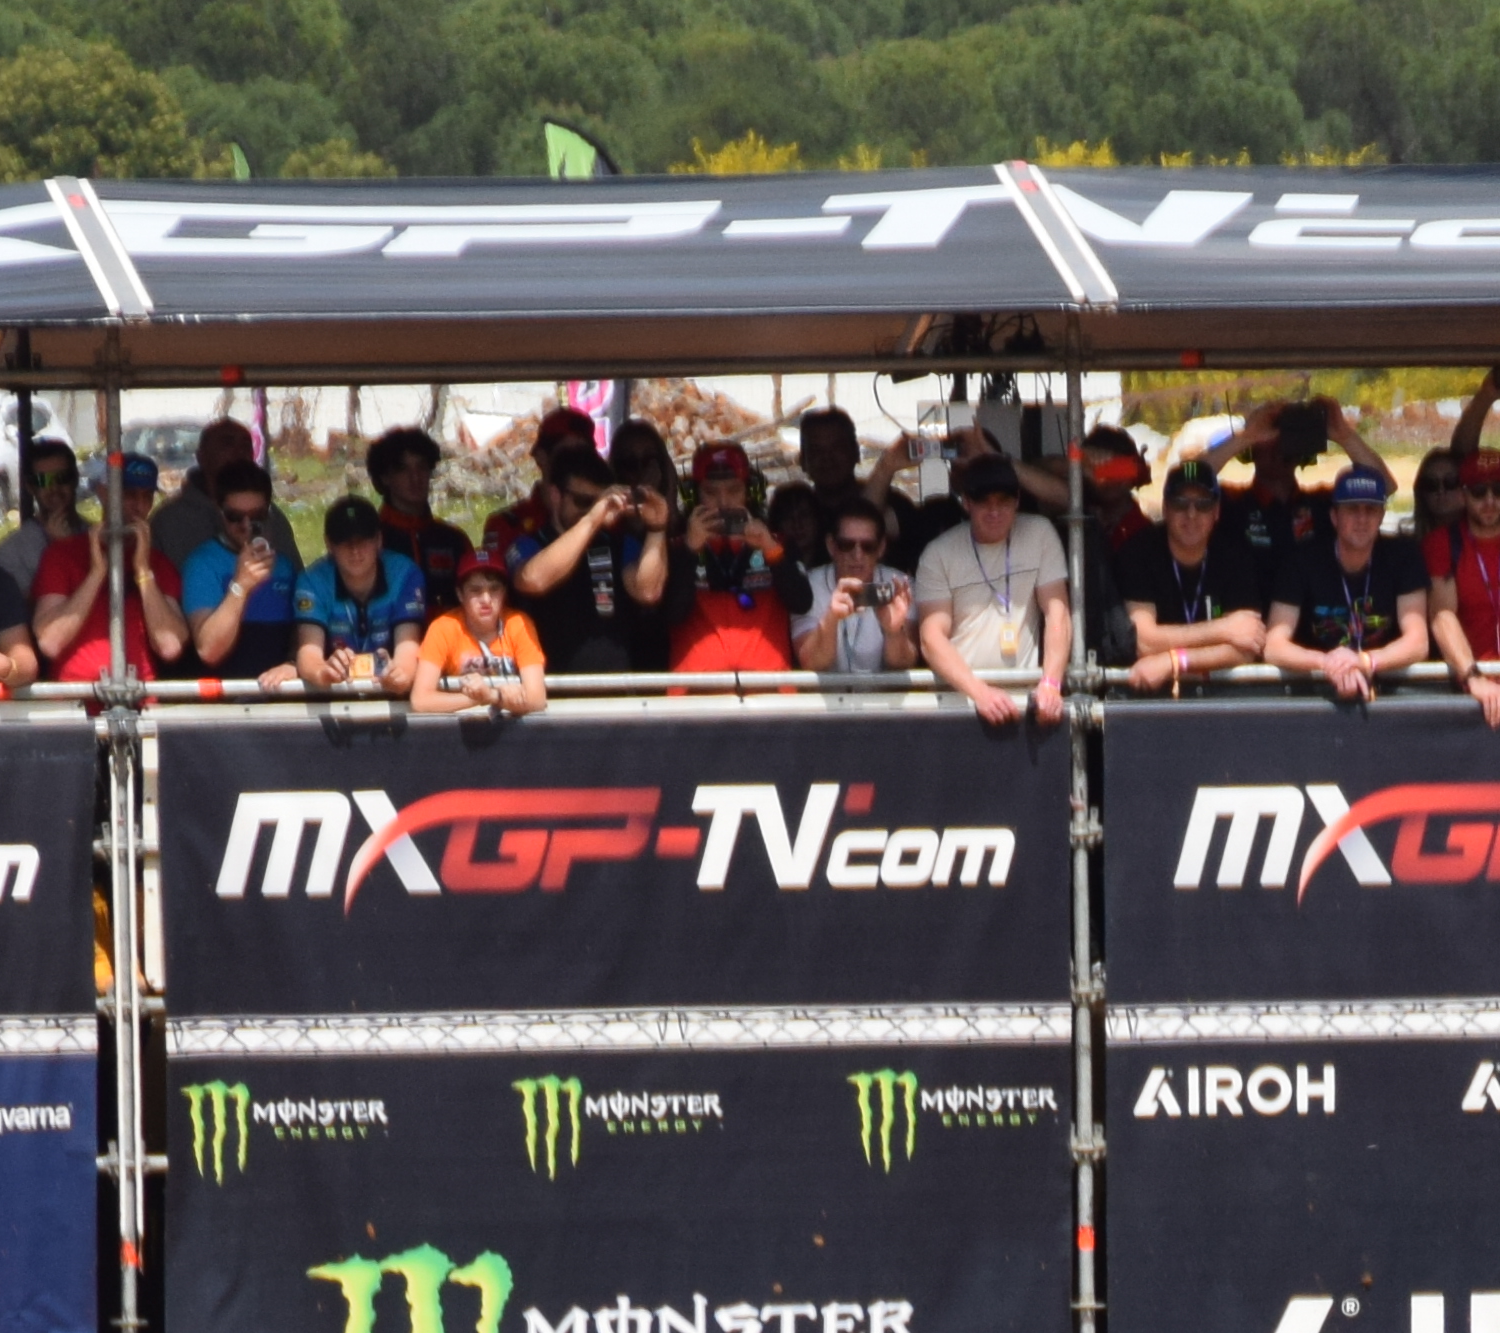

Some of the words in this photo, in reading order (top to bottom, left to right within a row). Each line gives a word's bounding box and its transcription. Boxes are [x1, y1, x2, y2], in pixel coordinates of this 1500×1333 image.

[921, 1084, 1057, 1114] MONSTER
[1133, 1062, 1336, 1117] AIROH
[252, 1097, 389, 1127] MONSTER
[584, 1091, 723, 1121] MONSTER
